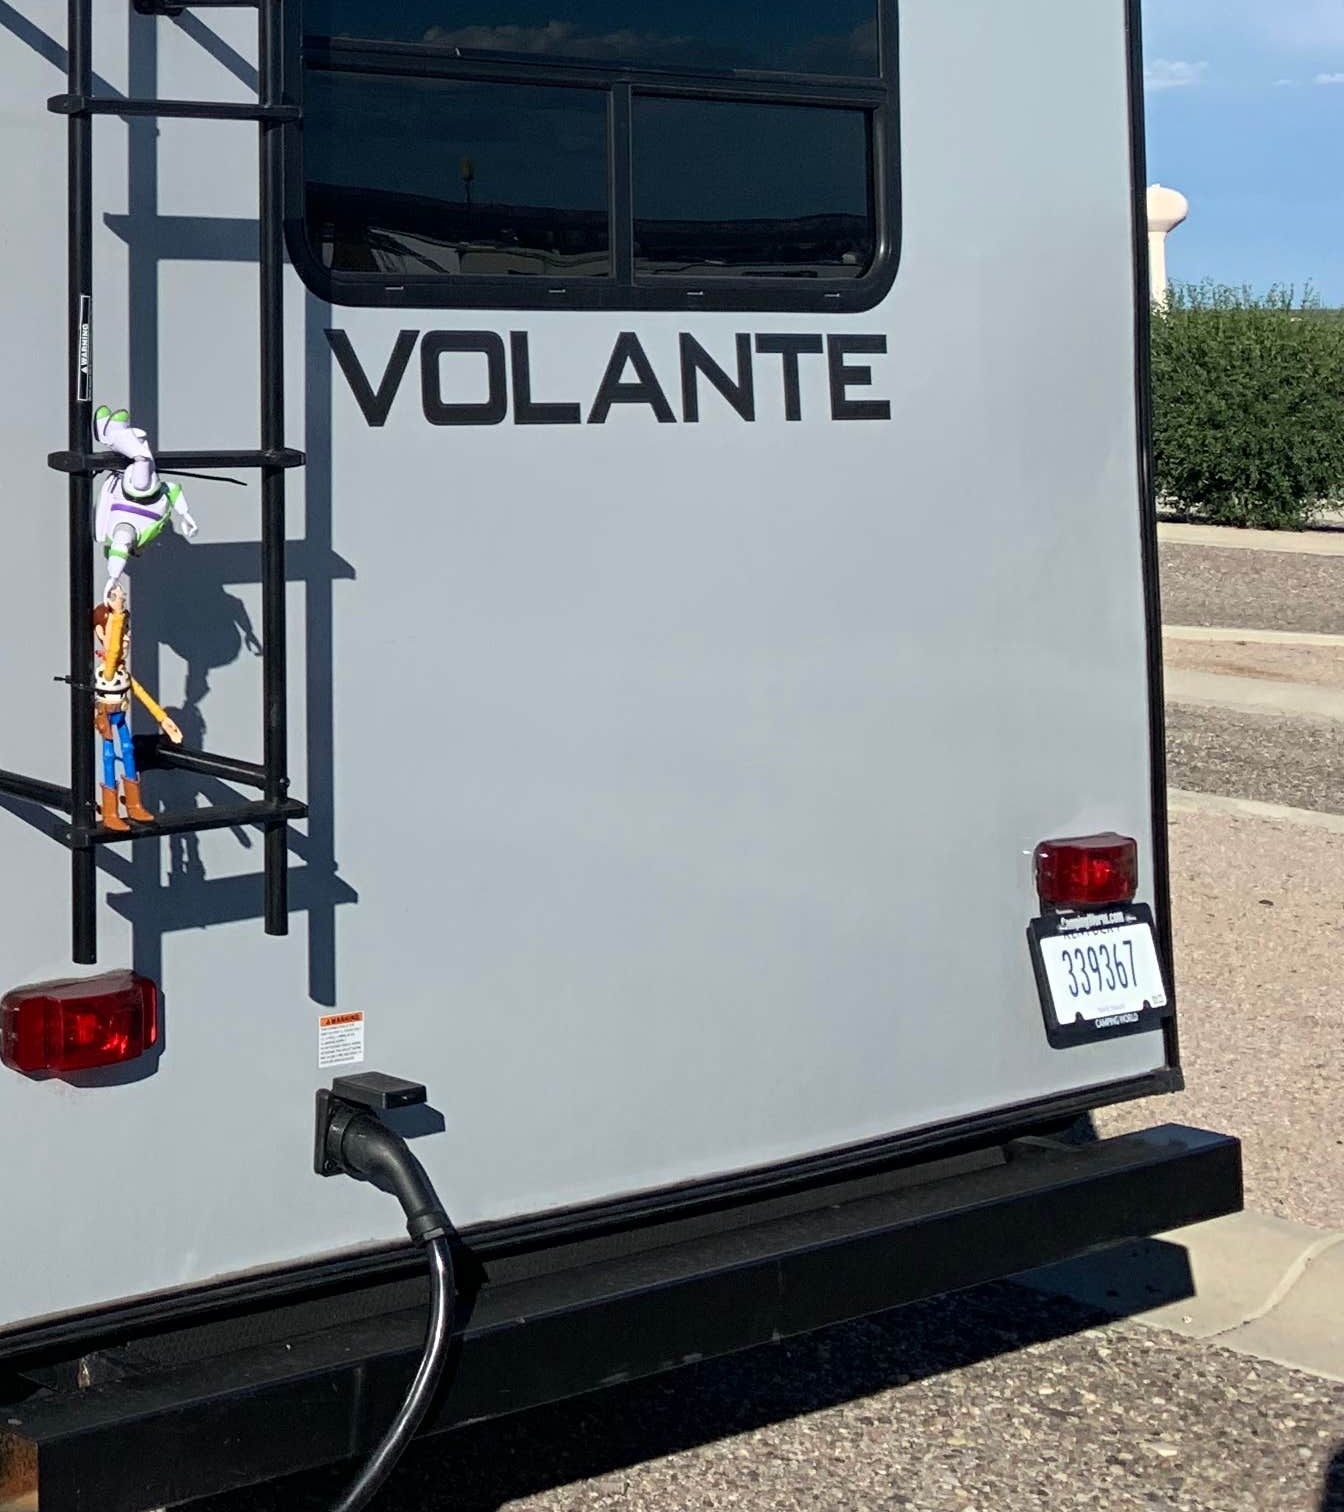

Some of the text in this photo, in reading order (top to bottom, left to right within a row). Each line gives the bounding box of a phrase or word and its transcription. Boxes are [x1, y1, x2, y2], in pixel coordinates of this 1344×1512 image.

[80, 323, 89, 365] WARNING
[323, 329, 892, 427] VOLANTE
[1062, 940, 1137, 997] 339367
